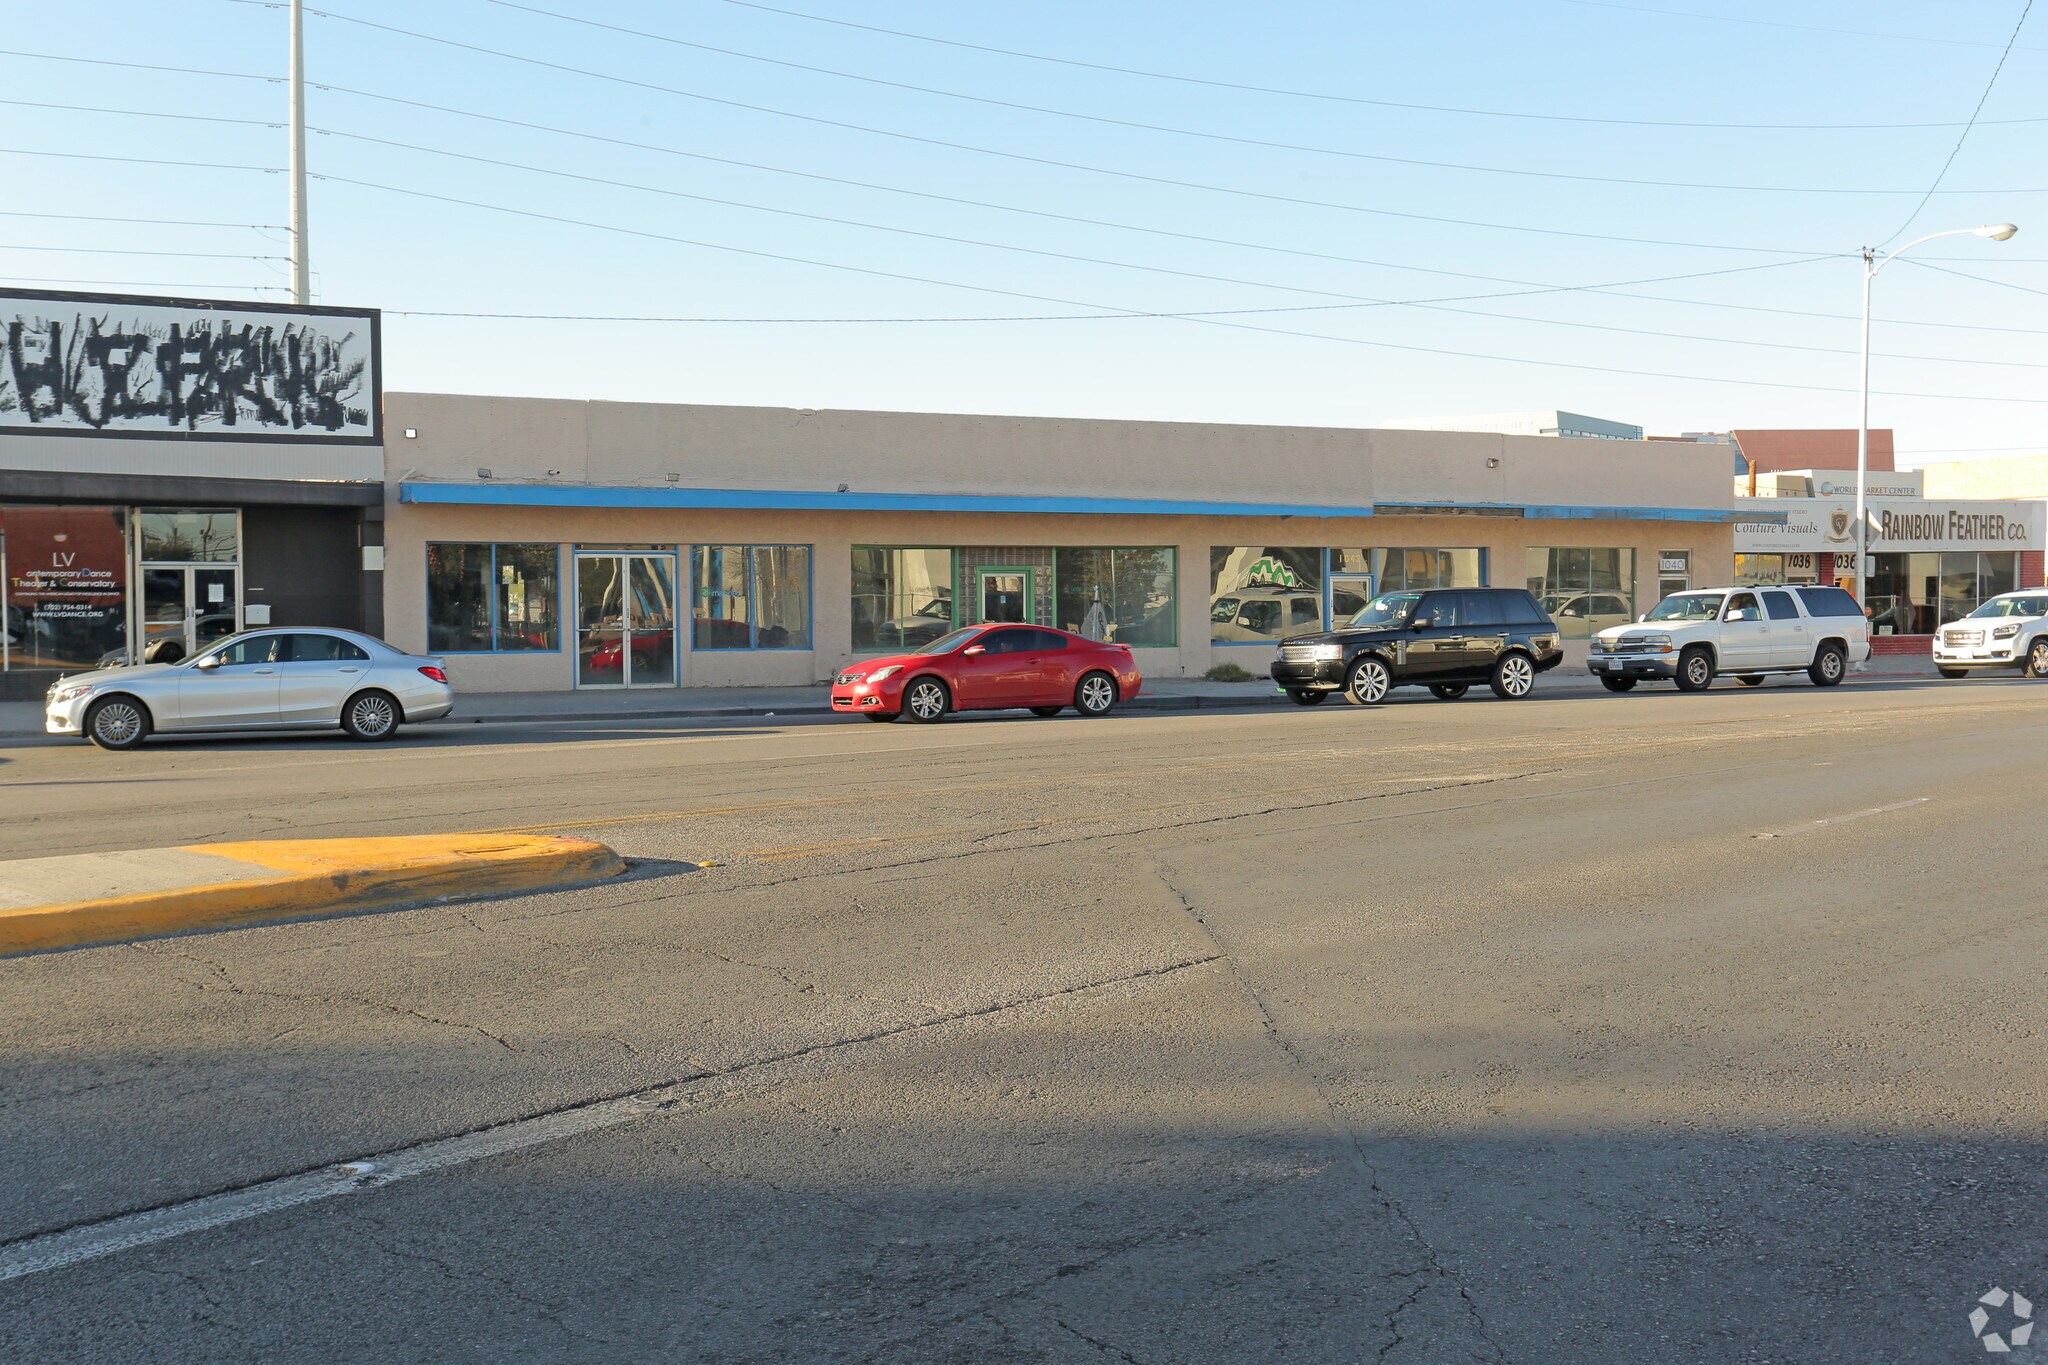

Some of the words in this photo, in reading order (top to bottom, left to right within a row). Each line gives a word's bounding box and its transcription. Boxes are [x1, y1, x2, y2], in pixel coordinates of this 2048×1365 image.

[1735, 522, 1777, 533] Couture
[1780, 522, 1818, 533] Visuals
[1882, 510, 1944, 540] RAINBOW
[1949, 510, 2004, 541] FEATHER
[53, 552, 75, 567] LV
[1339, 554, 1361, 563] 1042
[1788, 554, 1811, 568] 1038
[1834, 554, 1857, 569] 1036
[1661, 560, 1685, 569] 1040
[82, 568, 112, 577] Dance
[60, 578, 115, 588] Conservatory
